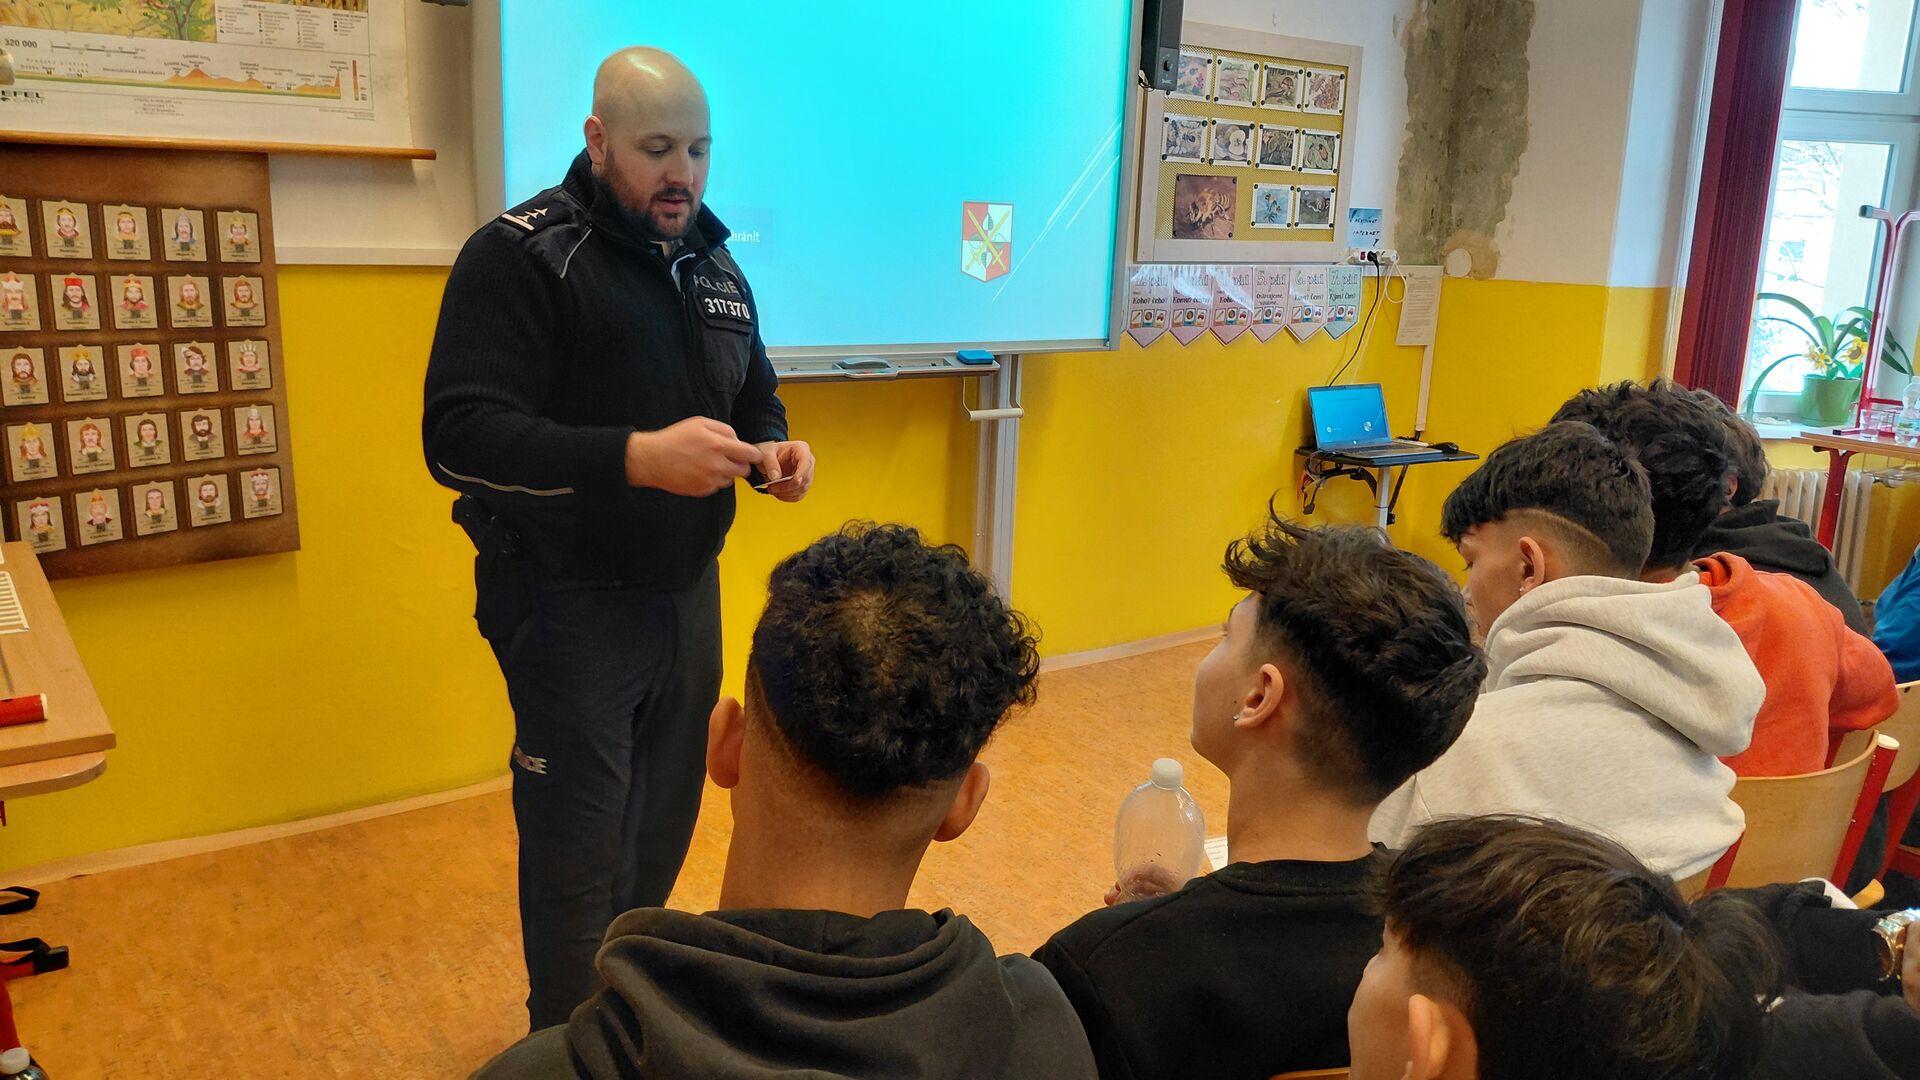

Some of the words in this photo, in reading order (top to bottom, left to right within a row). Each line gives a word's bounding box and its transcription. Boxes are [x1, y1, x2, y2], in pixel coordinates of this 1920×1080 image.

[4, 38, 20, 47] 320
[22, 40, 38, 49] 000
[693, 274, 739, 294] POLCIE
[705, 298, 750, 319] 317370
